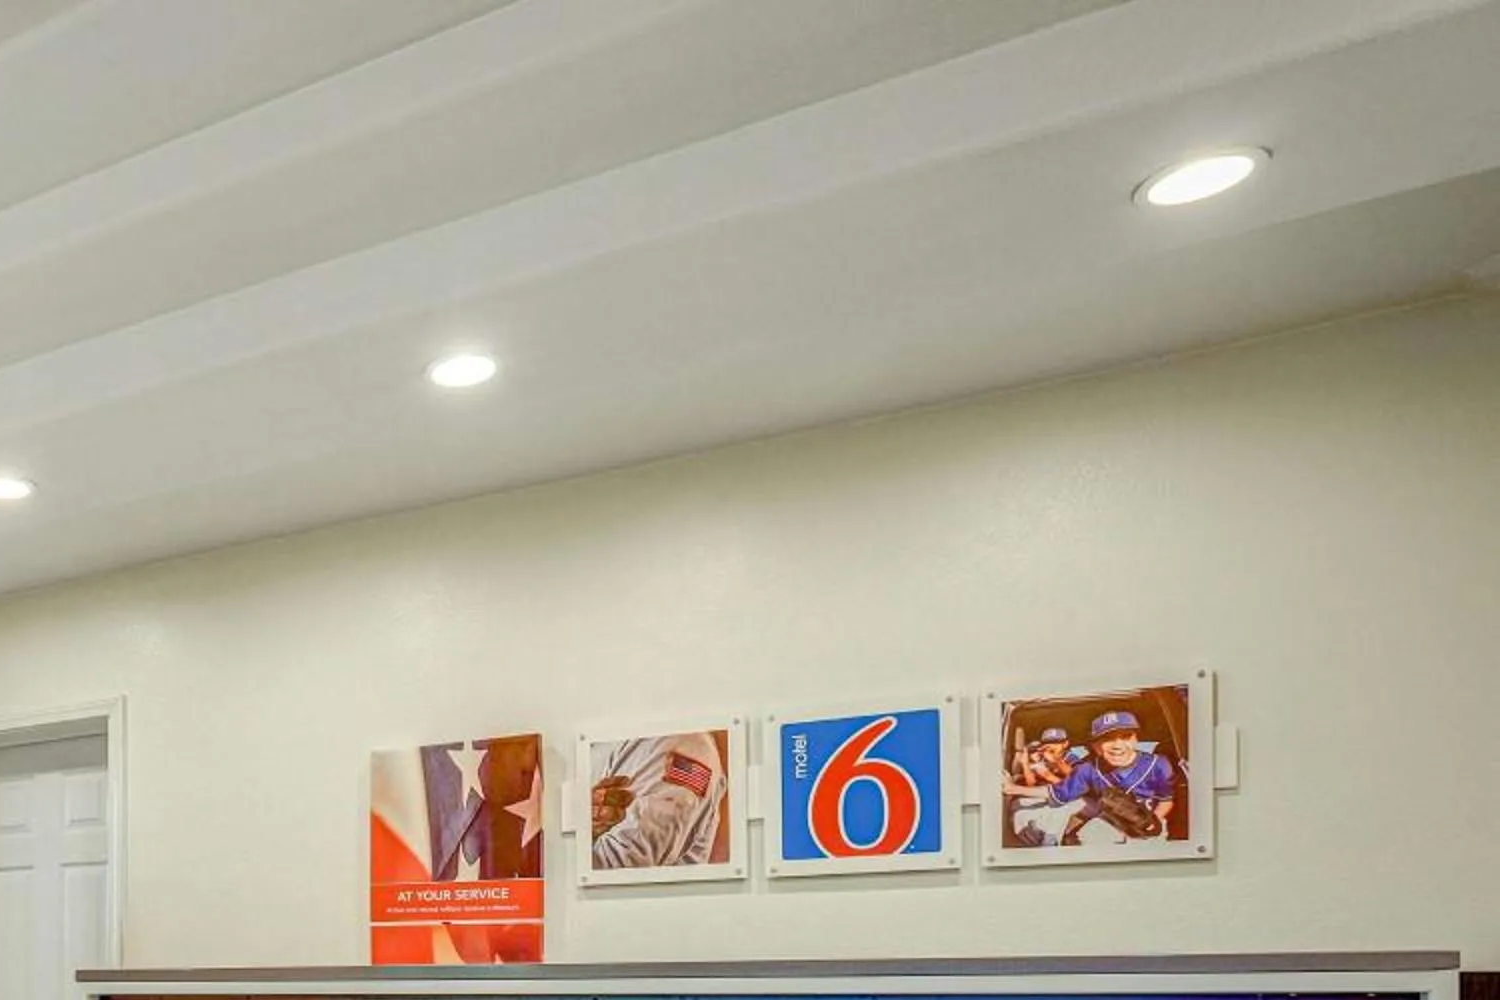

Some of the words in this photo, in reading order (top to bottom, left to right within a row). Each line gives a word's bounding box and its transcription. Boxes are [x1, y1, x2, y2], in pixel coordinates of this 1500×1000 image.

[791, 734, 807, 779] motel
[807, 716, 921, 859] 6
[397, 891, 412, 902] AT
[416, 889, 451, 901] YOUR
[455, 887, 510, 900] SERVICE
